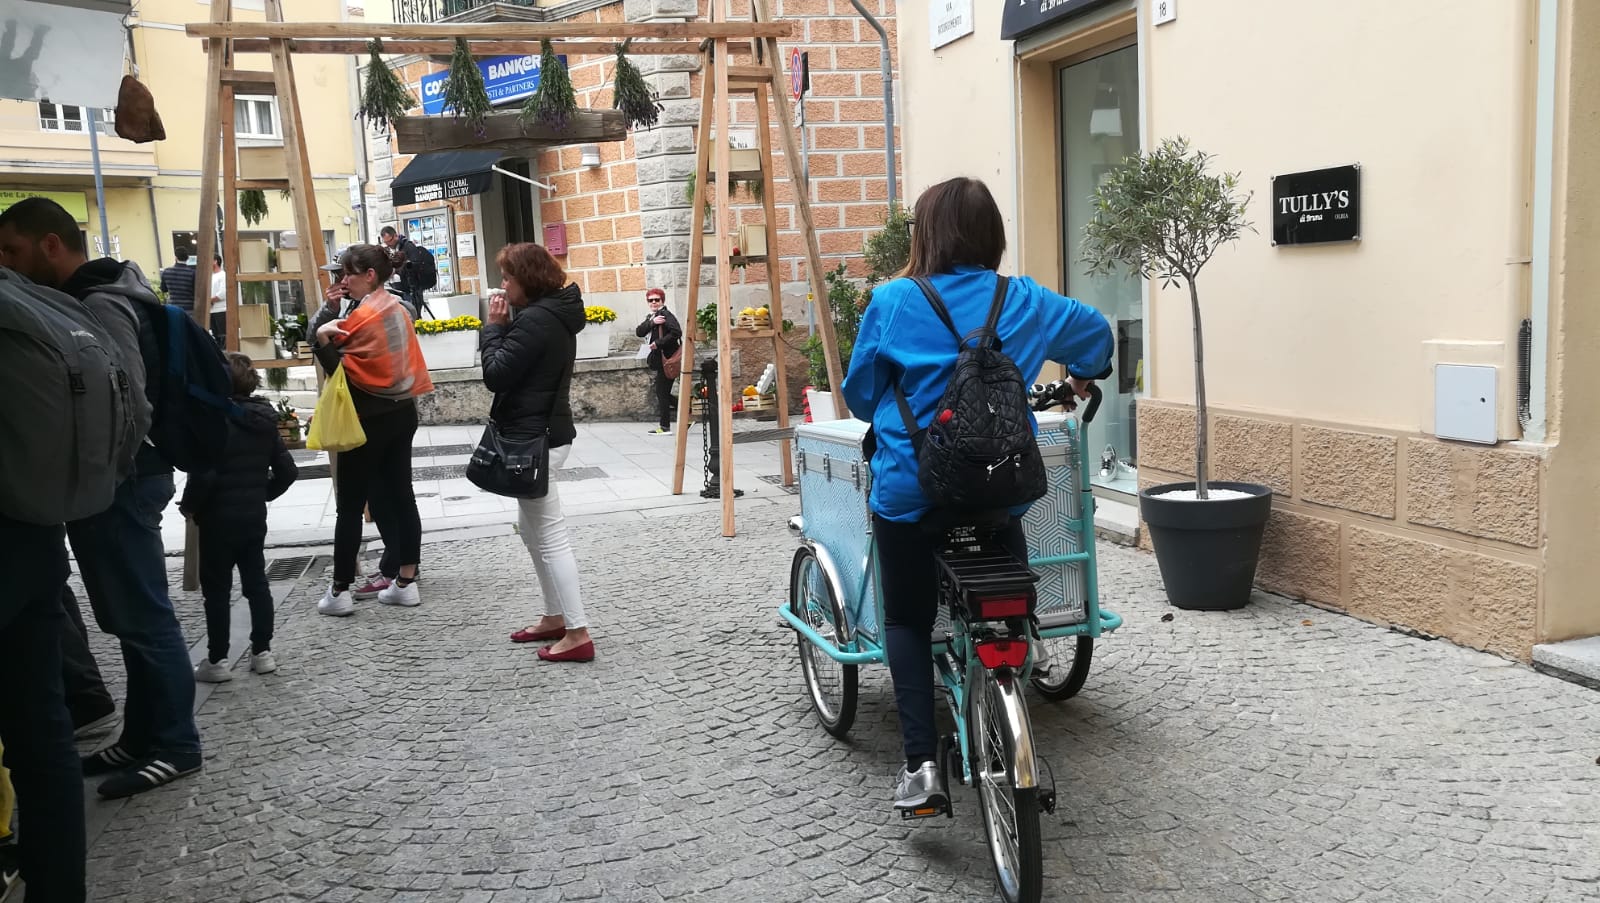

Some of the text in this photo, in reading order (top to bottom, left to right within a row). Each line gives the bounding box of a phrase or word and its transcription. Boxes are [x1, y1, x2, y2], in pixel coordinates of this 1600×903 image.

[1159, 1, 1167, 18] 18
[488, 54, 542, 80] BANKER
[505, 80, 535, 95] PARTNERS
[415, 182, 442, 194] COLDWELL
[447, 178, 468, 189] GLOBAL
[415, 191, 437, 202] BANKER
[447, 187, 469, 198] LUXURY
[1279, 190, 1349, 214] TULLY'S
